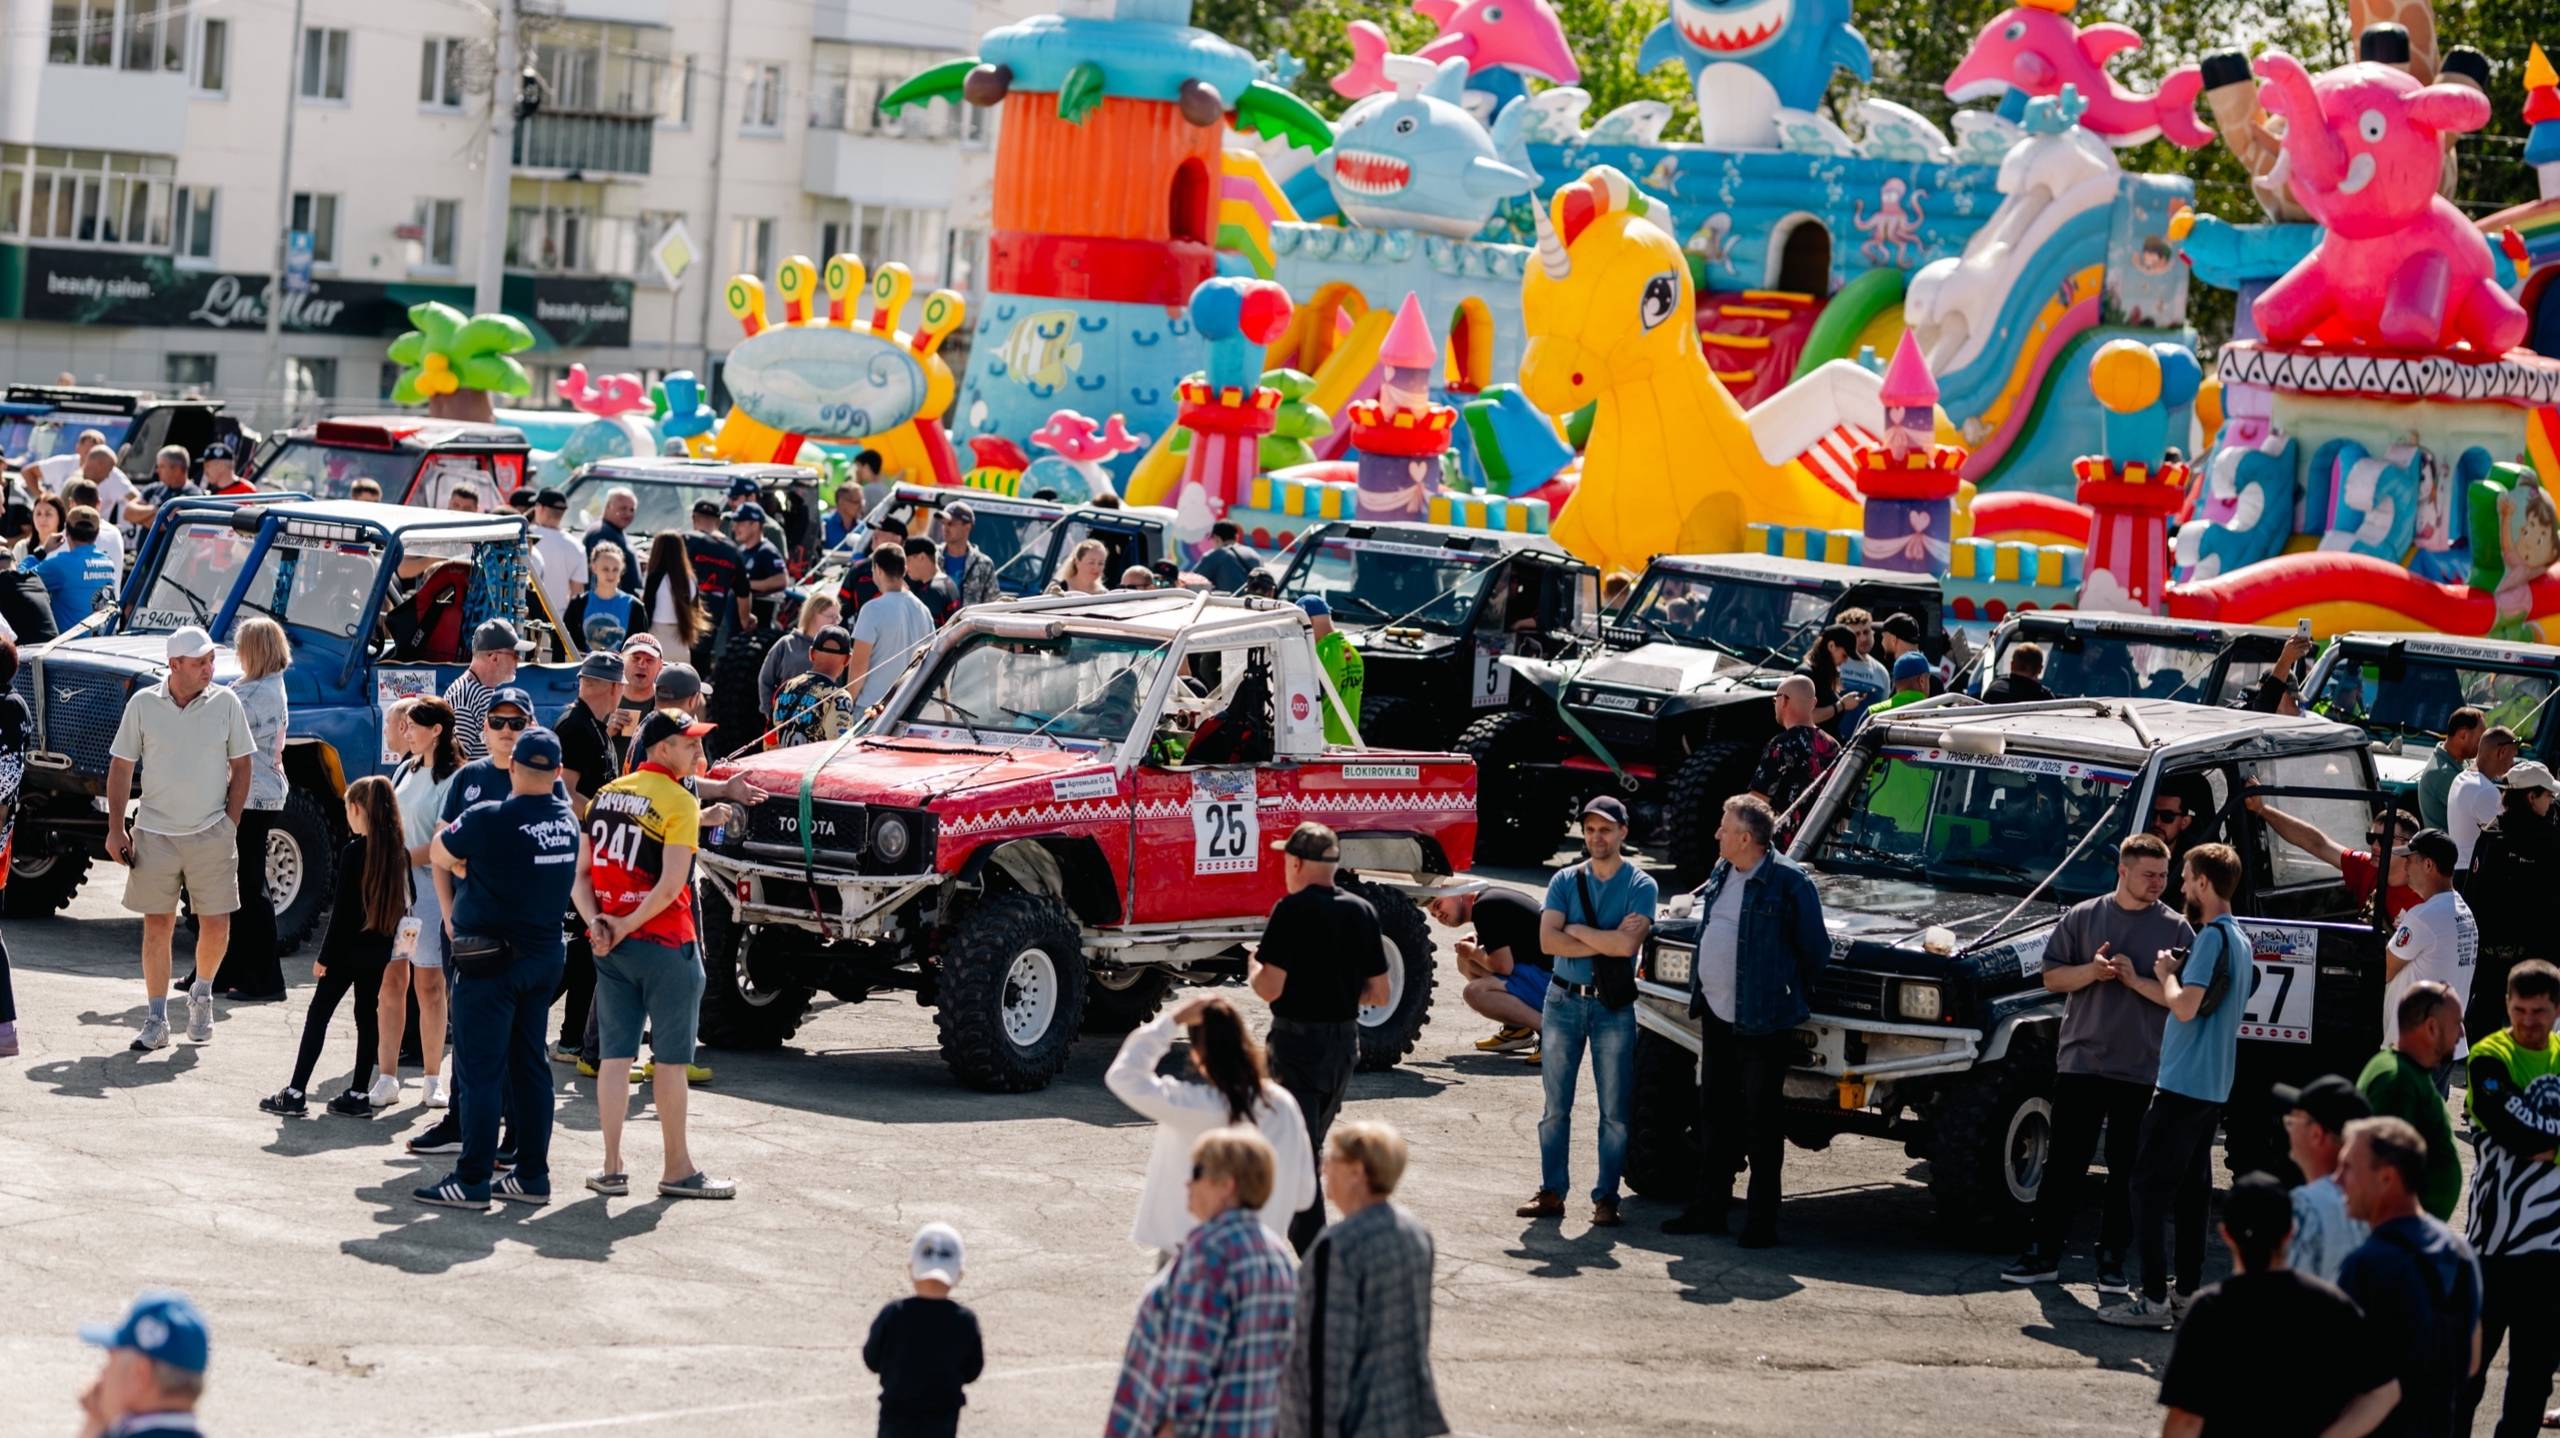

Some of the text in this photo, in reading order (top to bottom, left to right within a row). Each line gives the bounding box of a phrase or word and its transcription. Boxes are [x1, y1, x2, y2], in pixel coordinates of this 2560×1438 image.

[48, 271, 101, 298] beauty
[537, 299, 627, 324] beauty salon
[2456, 646, 2482, 658] РОССИИ
[2481, 649, 2500, 659] 2025
[1486, 656, 1499, 695] 5
[1344, 767, 1418, 778] BLOKIROVKA.RU
[1947, 751, 2005, 766] ТРОФИ-РЕЙДЫ
[2006, 756, 2039, 770] РОССИИ
[2039, 761, 2062, 773] 2025
[778, 816, 836, 836] TOOTA
[1206, 804, 1247, 857] 25
[591, 819, 642, 871] 247
